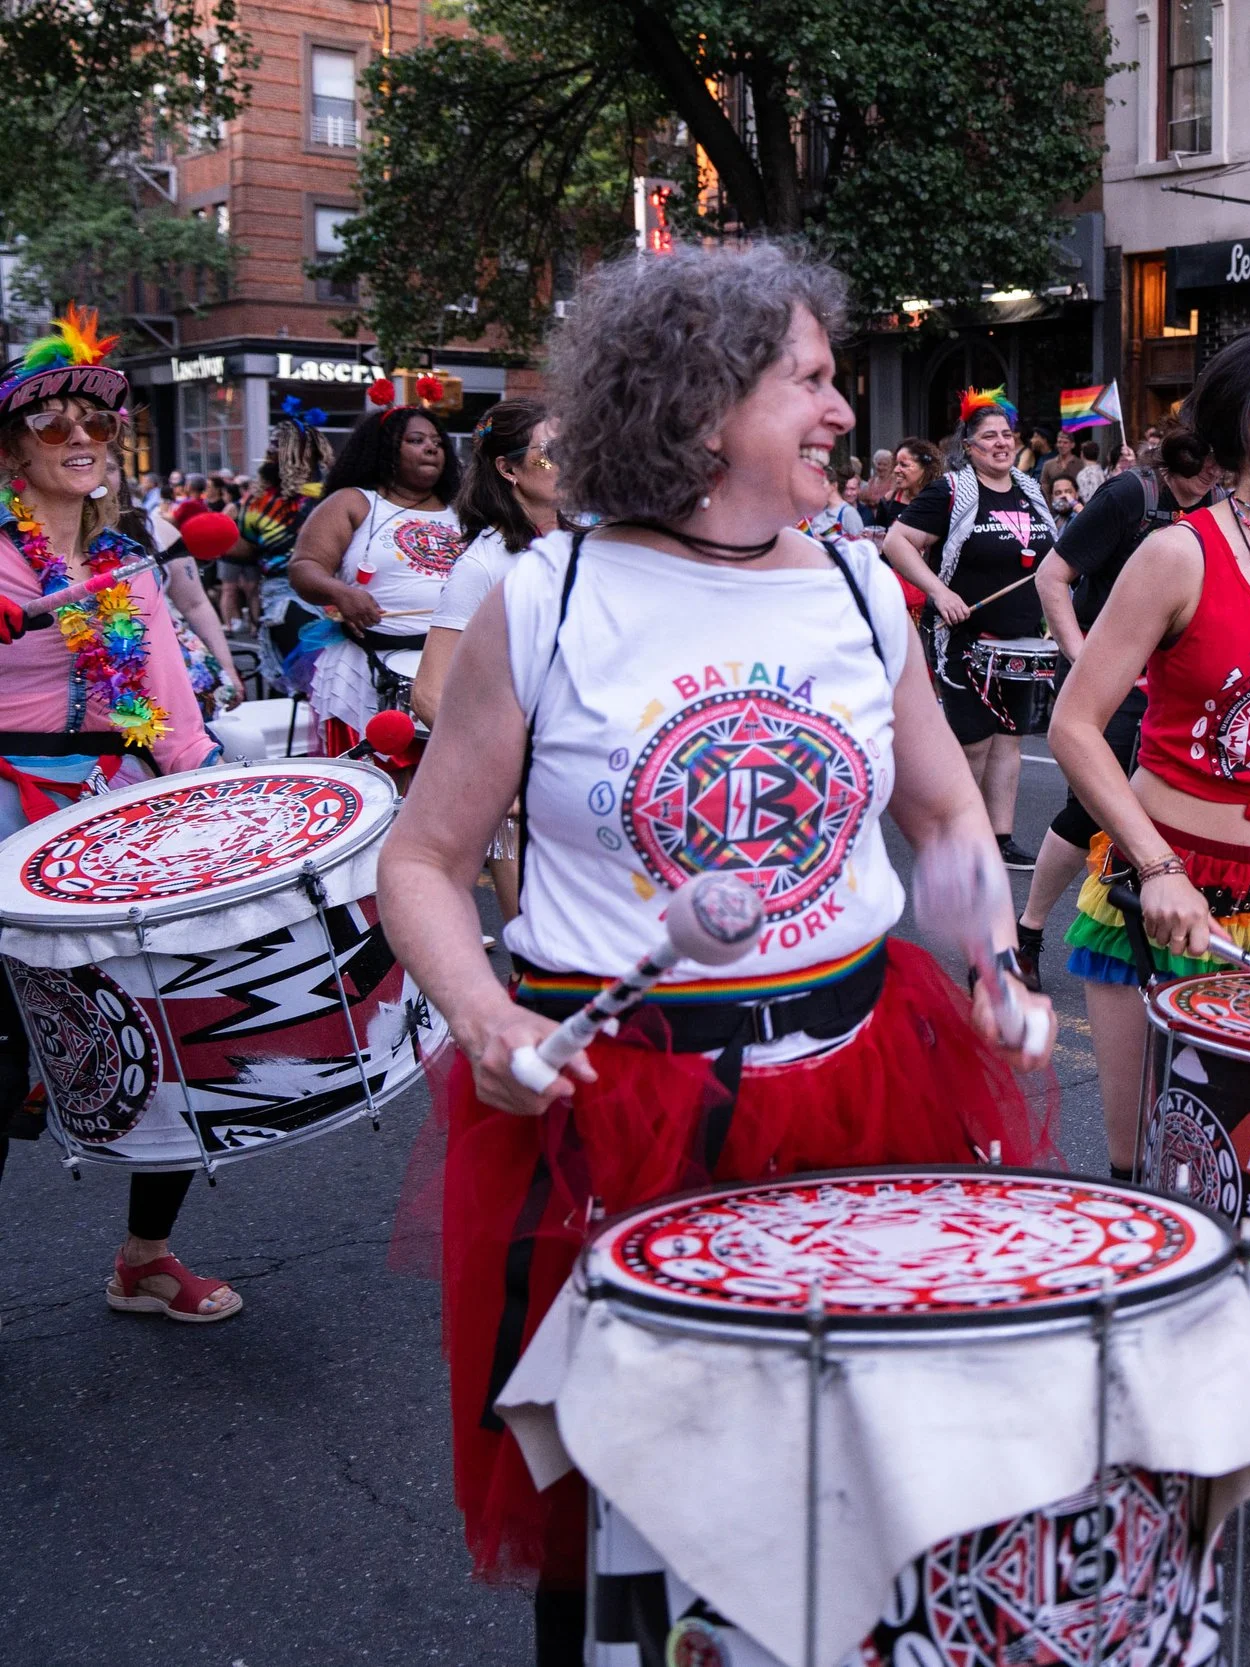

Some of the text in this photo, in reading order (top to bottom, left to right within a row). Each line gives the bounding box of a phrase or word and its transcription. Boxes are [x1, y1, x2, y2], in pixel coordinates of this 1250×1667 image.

[9, 369, 125, 412] NEW YORK
[758, 890, 846, 955] YORK
[1159, 1093, 1216, 1141] ATALA
